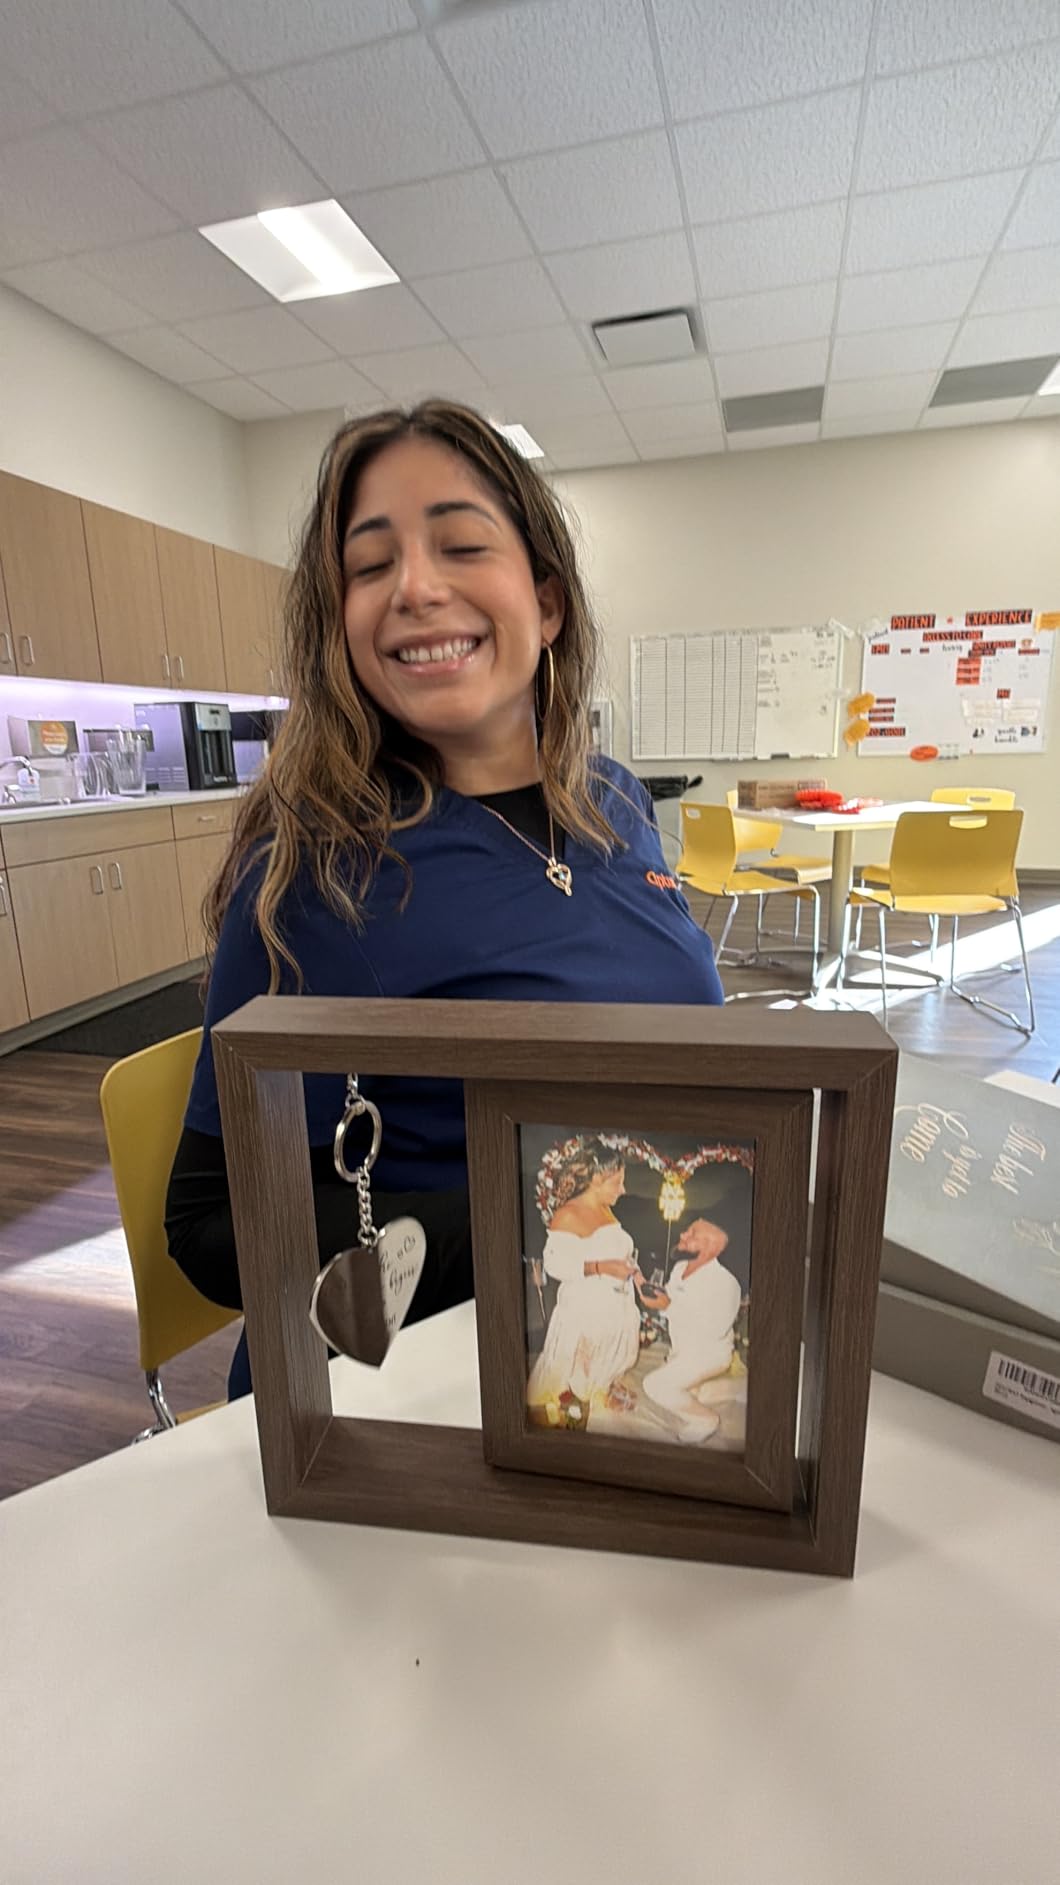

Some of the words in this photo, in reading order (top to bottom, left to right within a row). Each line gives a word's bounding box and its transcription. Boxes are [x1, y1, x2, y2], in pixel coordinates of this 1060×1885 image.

[891, 615, 935, 630] PATIENT
[965, 610, 1032, 626] EXPERIENCE
[990, 1153, 1034, 1195] best
